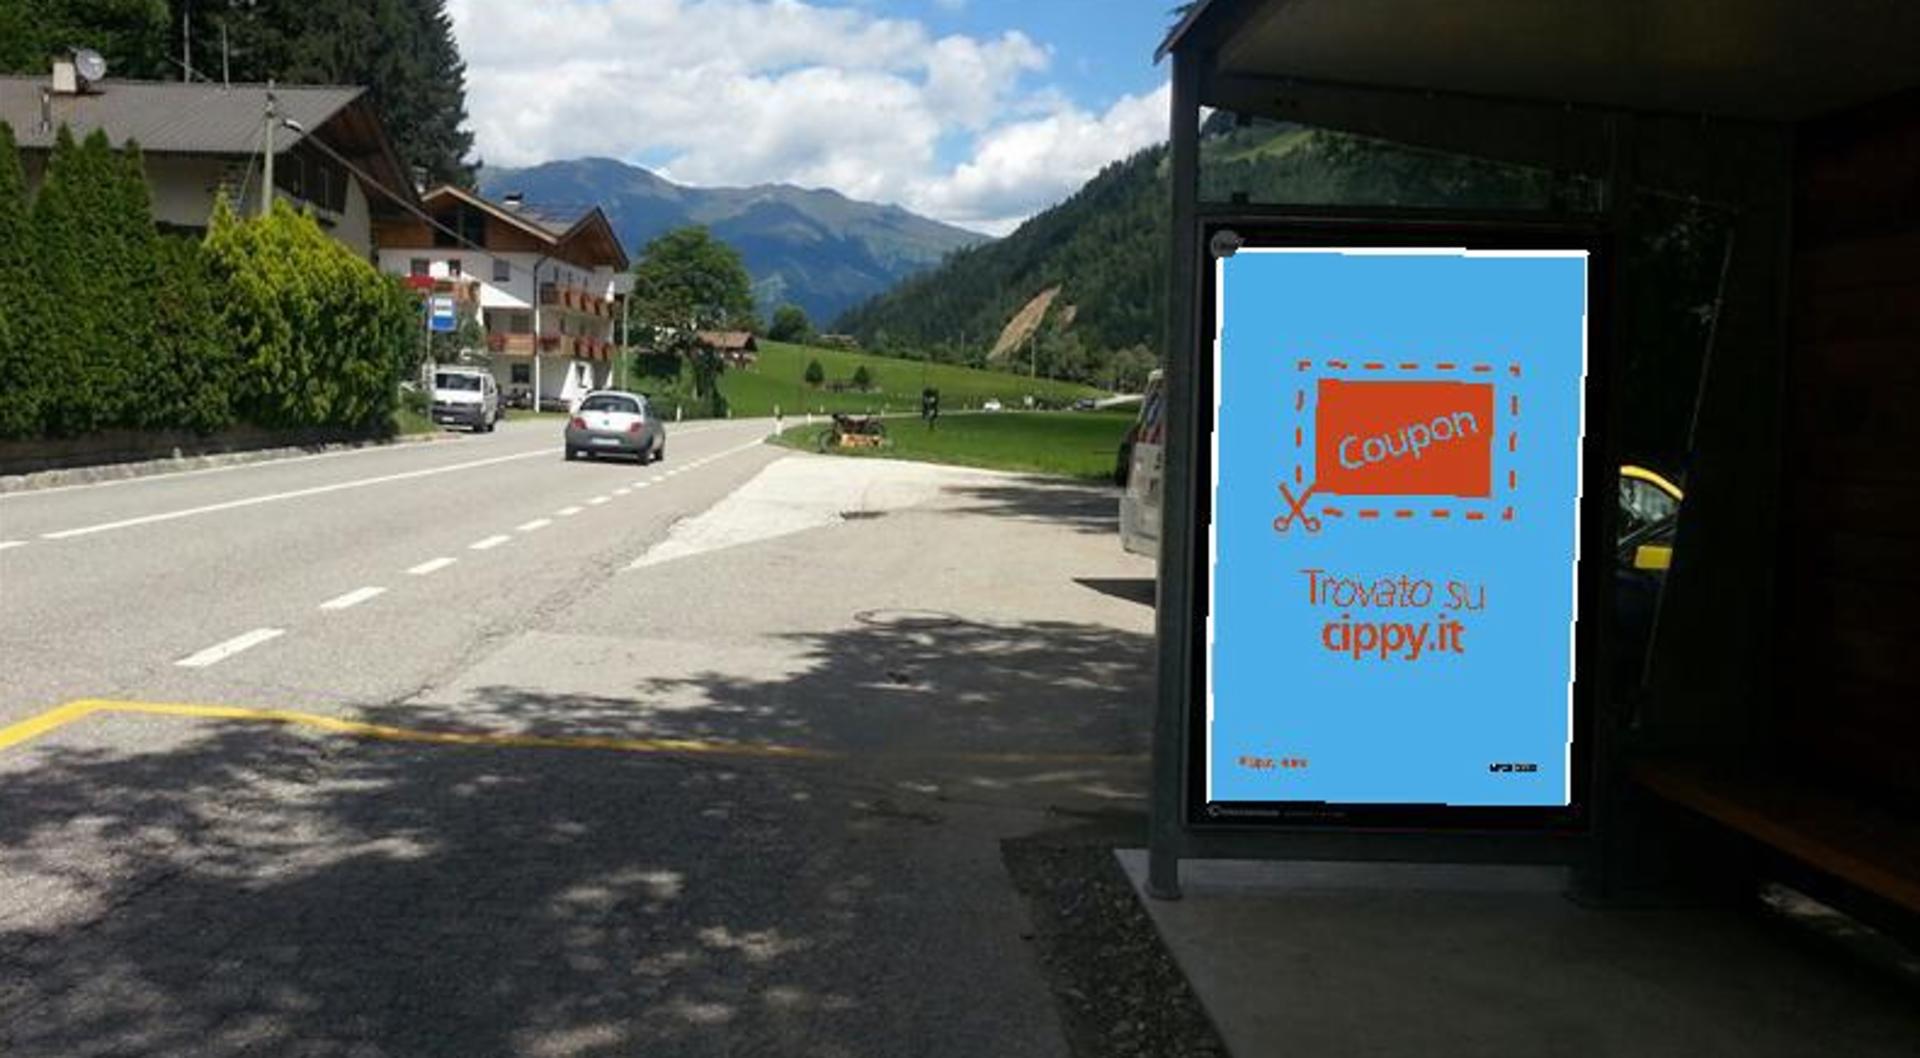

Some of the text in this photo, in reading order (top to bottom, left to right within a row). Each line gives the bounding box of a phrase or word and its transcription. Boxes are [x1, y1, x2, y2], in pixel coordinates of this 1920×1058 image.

[1338, 411, 1478, 470] Coupon
[1301, 569, 1486, 611] Trovato su
[1321, 613, 1466, 661] cippy.it
